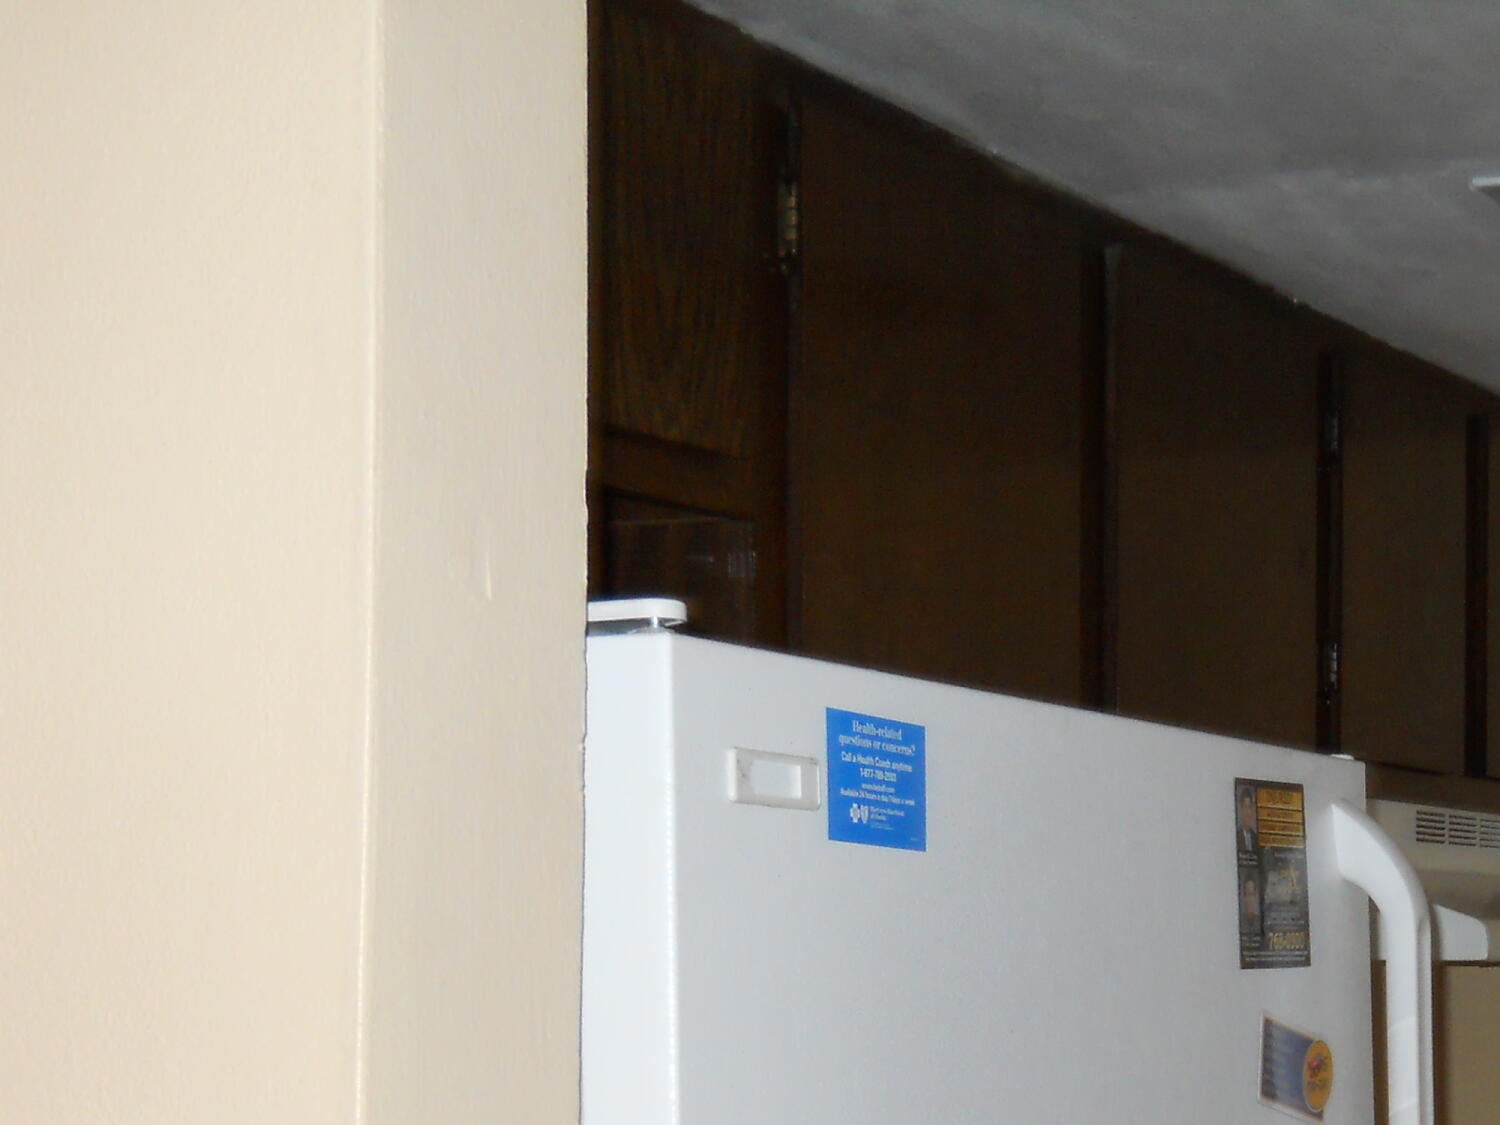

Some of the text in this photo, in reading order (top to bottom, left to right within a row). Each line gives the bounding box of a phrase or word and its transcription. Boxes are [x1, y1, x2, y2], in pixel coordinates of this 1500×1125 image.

[853, 721, 902, 740] Health-related
[839, 735, 916, 755] questions or concerns?
[841, 752, 851, 762] Call
[857, 755, 874, 765] Health
